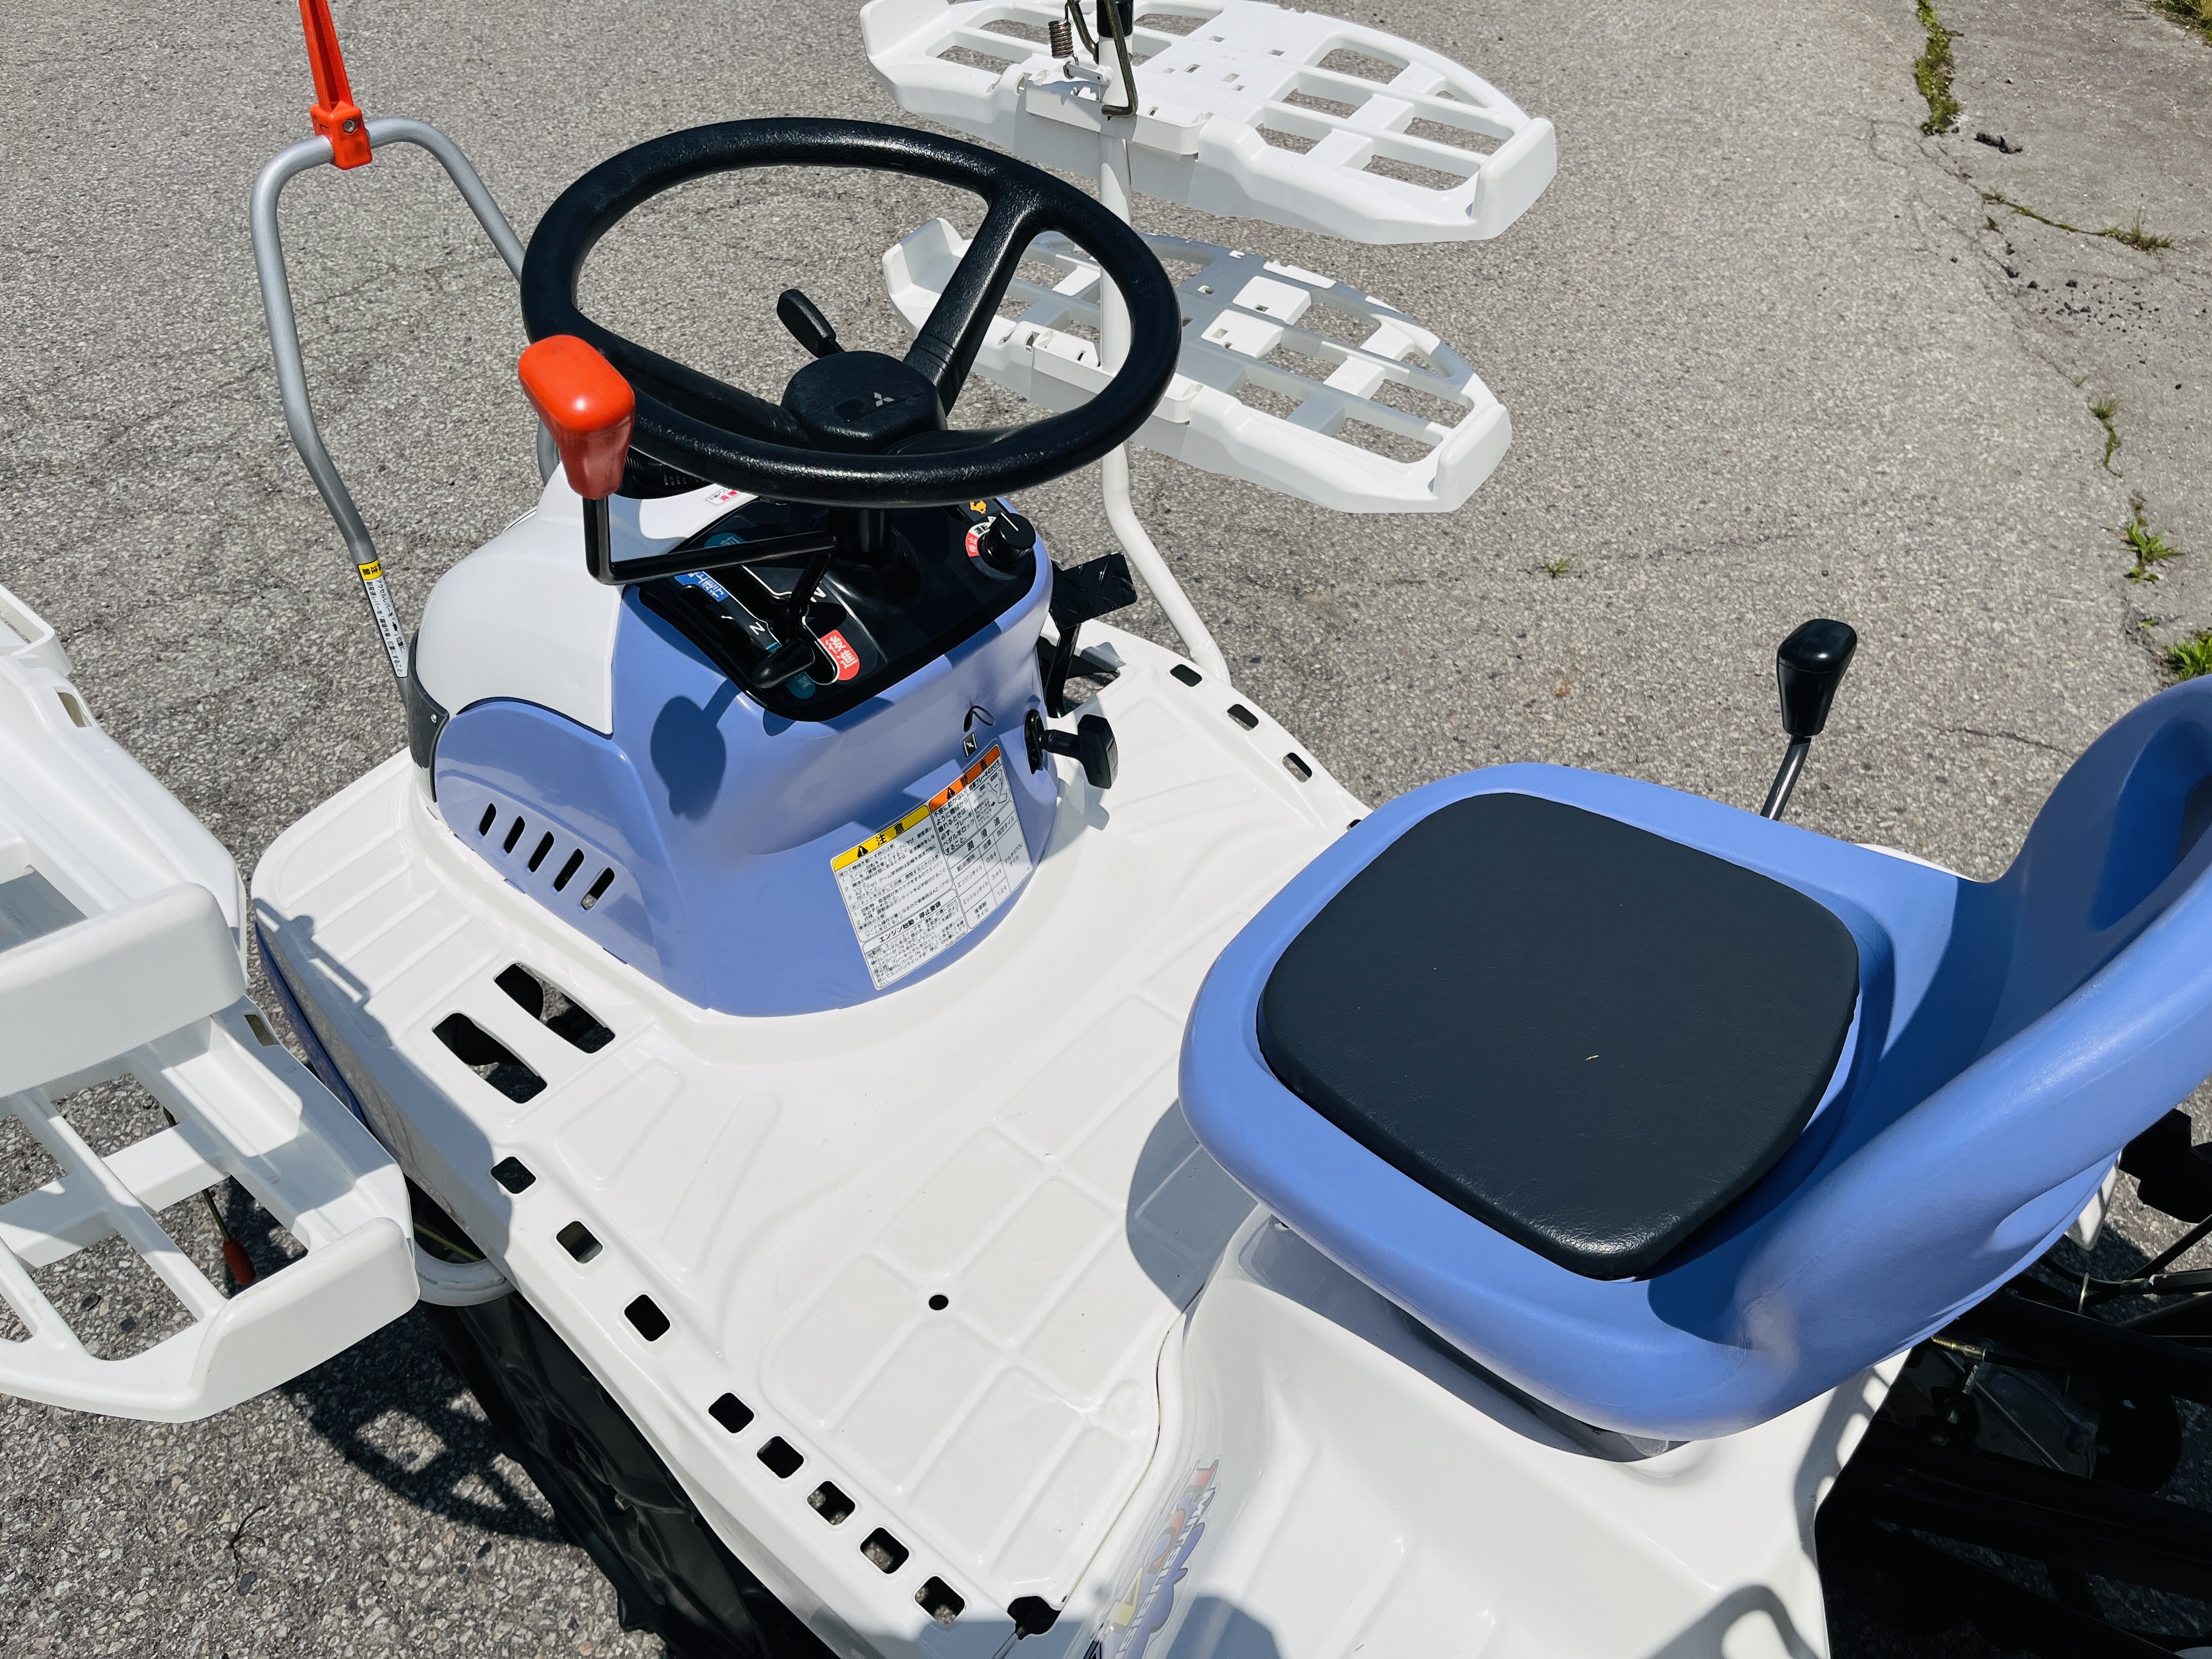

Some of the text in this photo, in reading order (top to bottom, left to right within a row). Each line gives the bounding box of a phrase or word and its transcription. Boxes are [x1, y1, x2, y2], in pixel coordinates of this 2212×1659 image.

[749, 621, 765, 635] N
[825, 635, 858, 670] 後進
[874, 821, 905, 847] 注意
[943, 818, 975, 848] ペダルをロック
[945, 833, 967, 855] すること。
[1008, 854, 1019, 867] オイル
[976, 905, 989, 922] オイル
[1116, 1487, 1216, 1658] MITSUBIS
